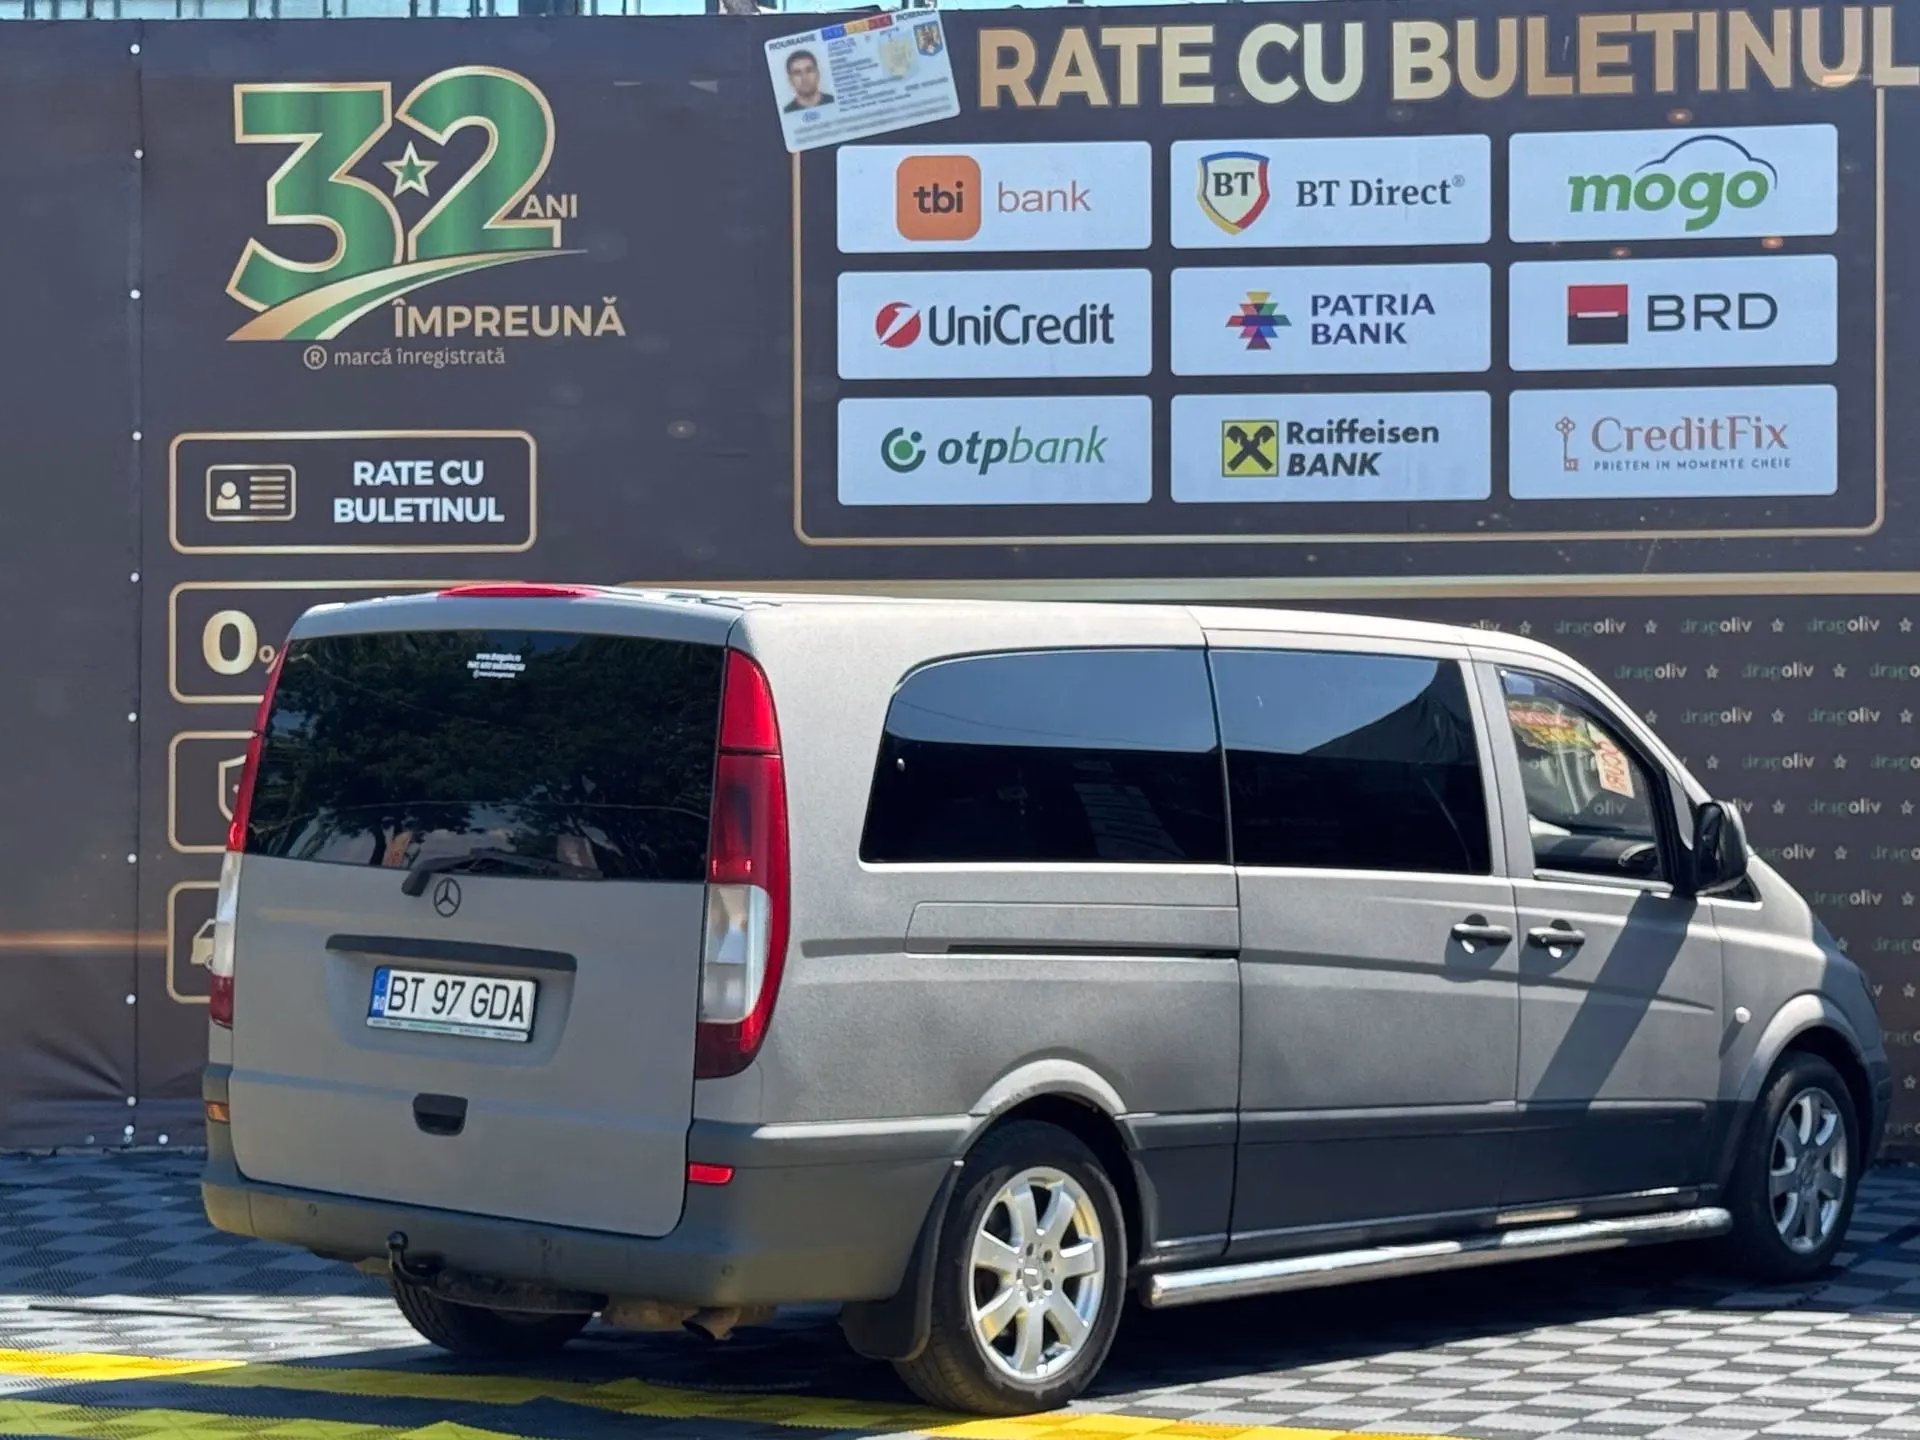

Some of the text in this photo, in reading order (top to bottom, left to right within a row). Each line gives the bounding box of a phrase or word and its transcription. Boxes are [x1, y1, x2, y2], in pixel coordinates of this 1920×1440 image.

[979, 24, 1215, 107] RATE
[1238, 22, 1364, 104] CU
[1392, 6, 1920, 100] BULETINUL
[226, 65, 561, 312] 32
[913, 180, 963, 214] tbi
[997, 179, 1093, 213] bank
[1213, 171, 1256, 198] BT
[1296, 180, 1341, 208] BT
[521, 193, 578, 219] ANI
[1567, 169, 1769, 232] mogo
[392, 295, 626, 338] ÎMPREUNĂ
[1310, 293, 1436, 317] PATRIA
[1647, 292, 1779, 332] BRD
[928, 302, 1115, 346] UniCredit
[1310, 322, 1408, 345] BANK
[334, 348, 393, 366] marcă
[397, 347, 506, 369] înregistrată
[1286, 418, 1440, 445] Raiffeisen
[1591, 415, 1790, 453] CreditFix
[937, 425, 1109, 476] otpbank
[353, 460, 484, 486] RATE CU
[1286, 452, 1382, 477] BANK
[1594, 457, 1792, 472] PRIETEN IN MOMENTE CHEIE
[334, 497, 505, 523] BULETINUL
[1555, 618, 1627, 638] dragoliv
[1680, 617, 1753, 636] dragoliv
[1807, 616, 1880, 634] dragoliv
[1614, 661, 1920, 681] dragoliv dragoliv drago
[1681, 707, 1881, 726] dragoliv dragoliv
[1742, 752, 1920, 772] dragoliv drago
[1809, 798, 1881, 817] dragoliv
[1871, 845, 1920, 862] drago
[1872, 936, 1920, 954] drago
[388, 976, 525, 1023] BT 97 GDA
